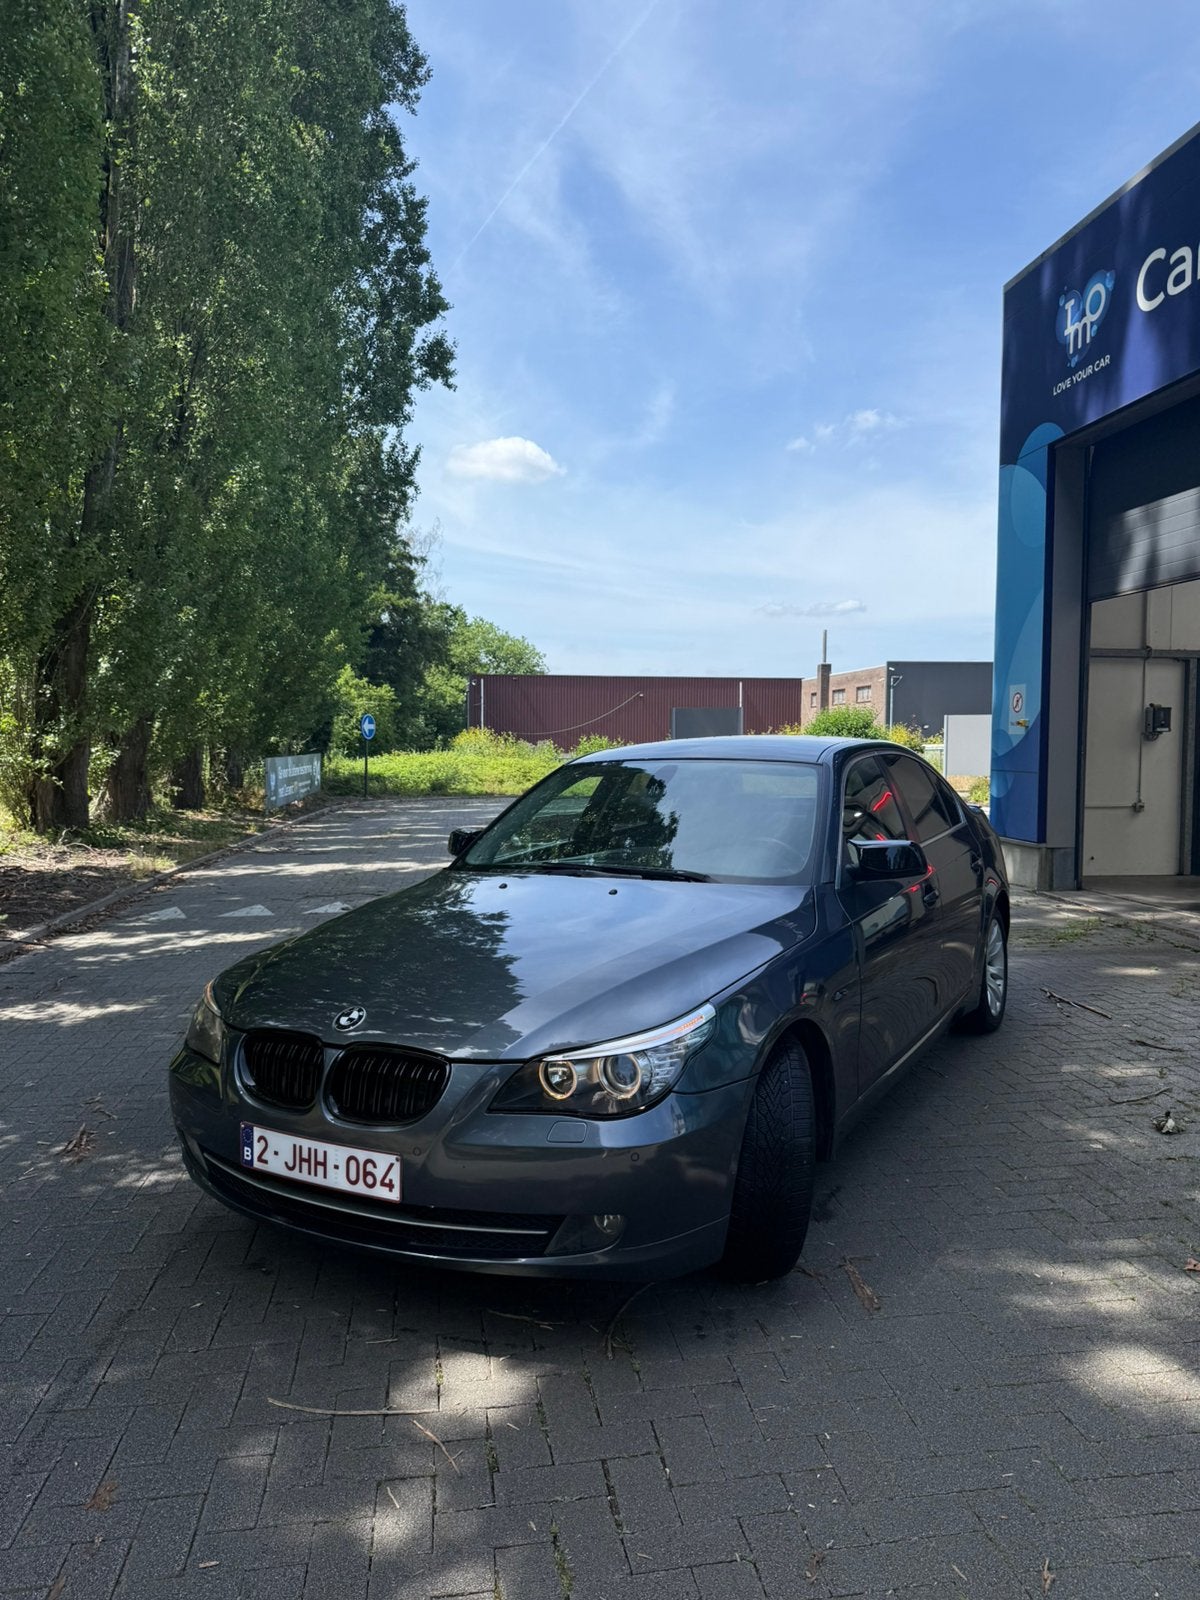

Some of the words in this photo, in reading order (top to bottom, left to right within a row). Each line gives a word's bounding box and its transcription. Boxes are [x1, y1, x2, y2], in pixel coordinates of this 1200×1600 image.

[1136, 242, 1200, 312] Ca
[1053, 377, 1071, 396] LOVE
[1072, 365, 1093, 384] YOUR
[1094, 354, 1110, 371] CAR
[243, 1146, 252, 1160] B
[256, 1135, 395, 1193] 2-JHH-064
